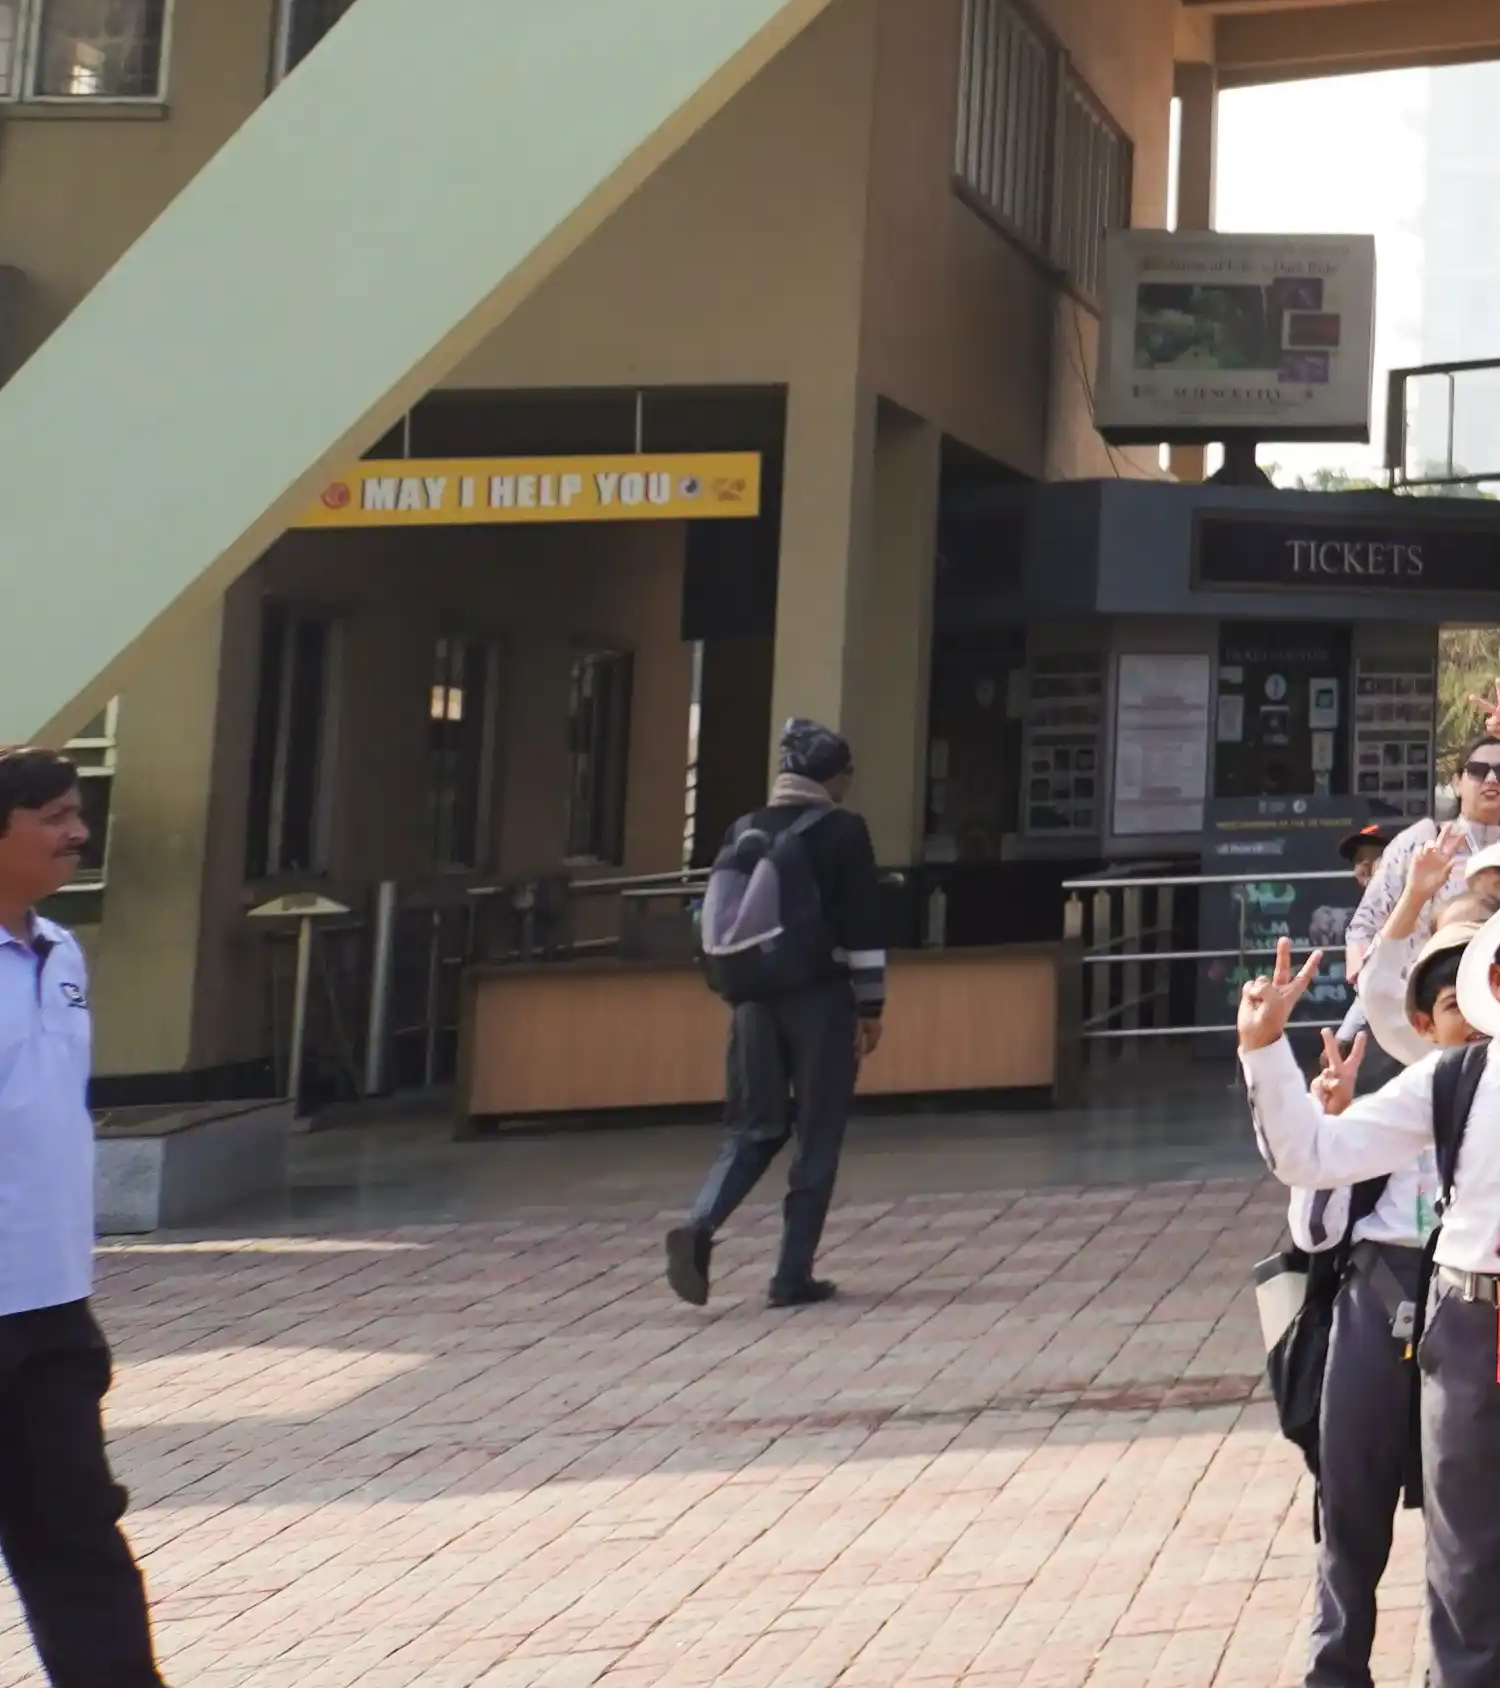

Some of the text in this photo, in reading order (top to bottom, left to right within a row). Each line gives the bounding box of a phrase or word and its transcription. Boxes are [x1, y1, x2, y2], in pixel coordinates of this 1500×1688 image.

[362, 471, 672, 511] MAY I HELP YOU
[1285, 539, 1424, 576] TICKETS
